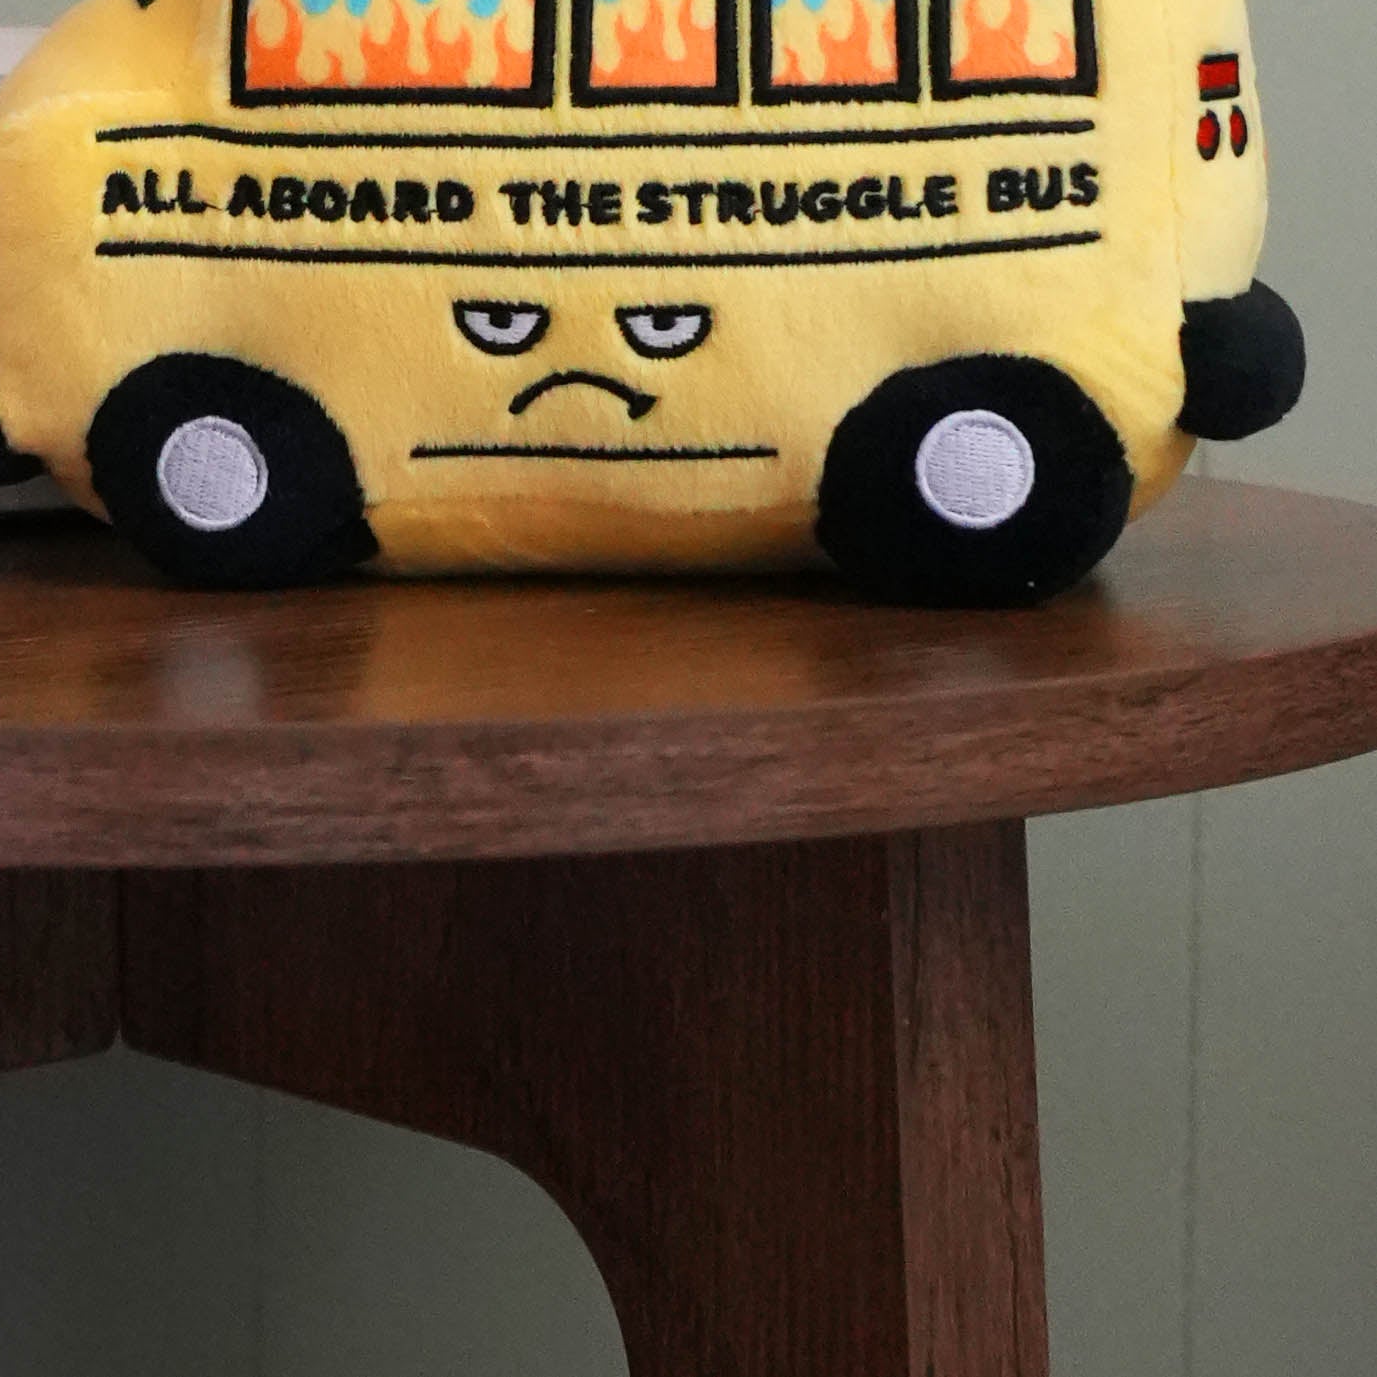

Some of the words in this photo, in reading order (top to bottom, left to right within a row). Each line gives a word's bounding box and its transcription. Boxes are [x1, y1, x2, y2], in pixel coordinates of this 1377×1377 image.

[100, 170, 207, 216] ALL
[225, 174, 475, 224] ABOARD
[498, 180, 622, 226] THE
[635, 175, 959, 226] STRUGGLE
[986, 163, 1100, 213] BUS
